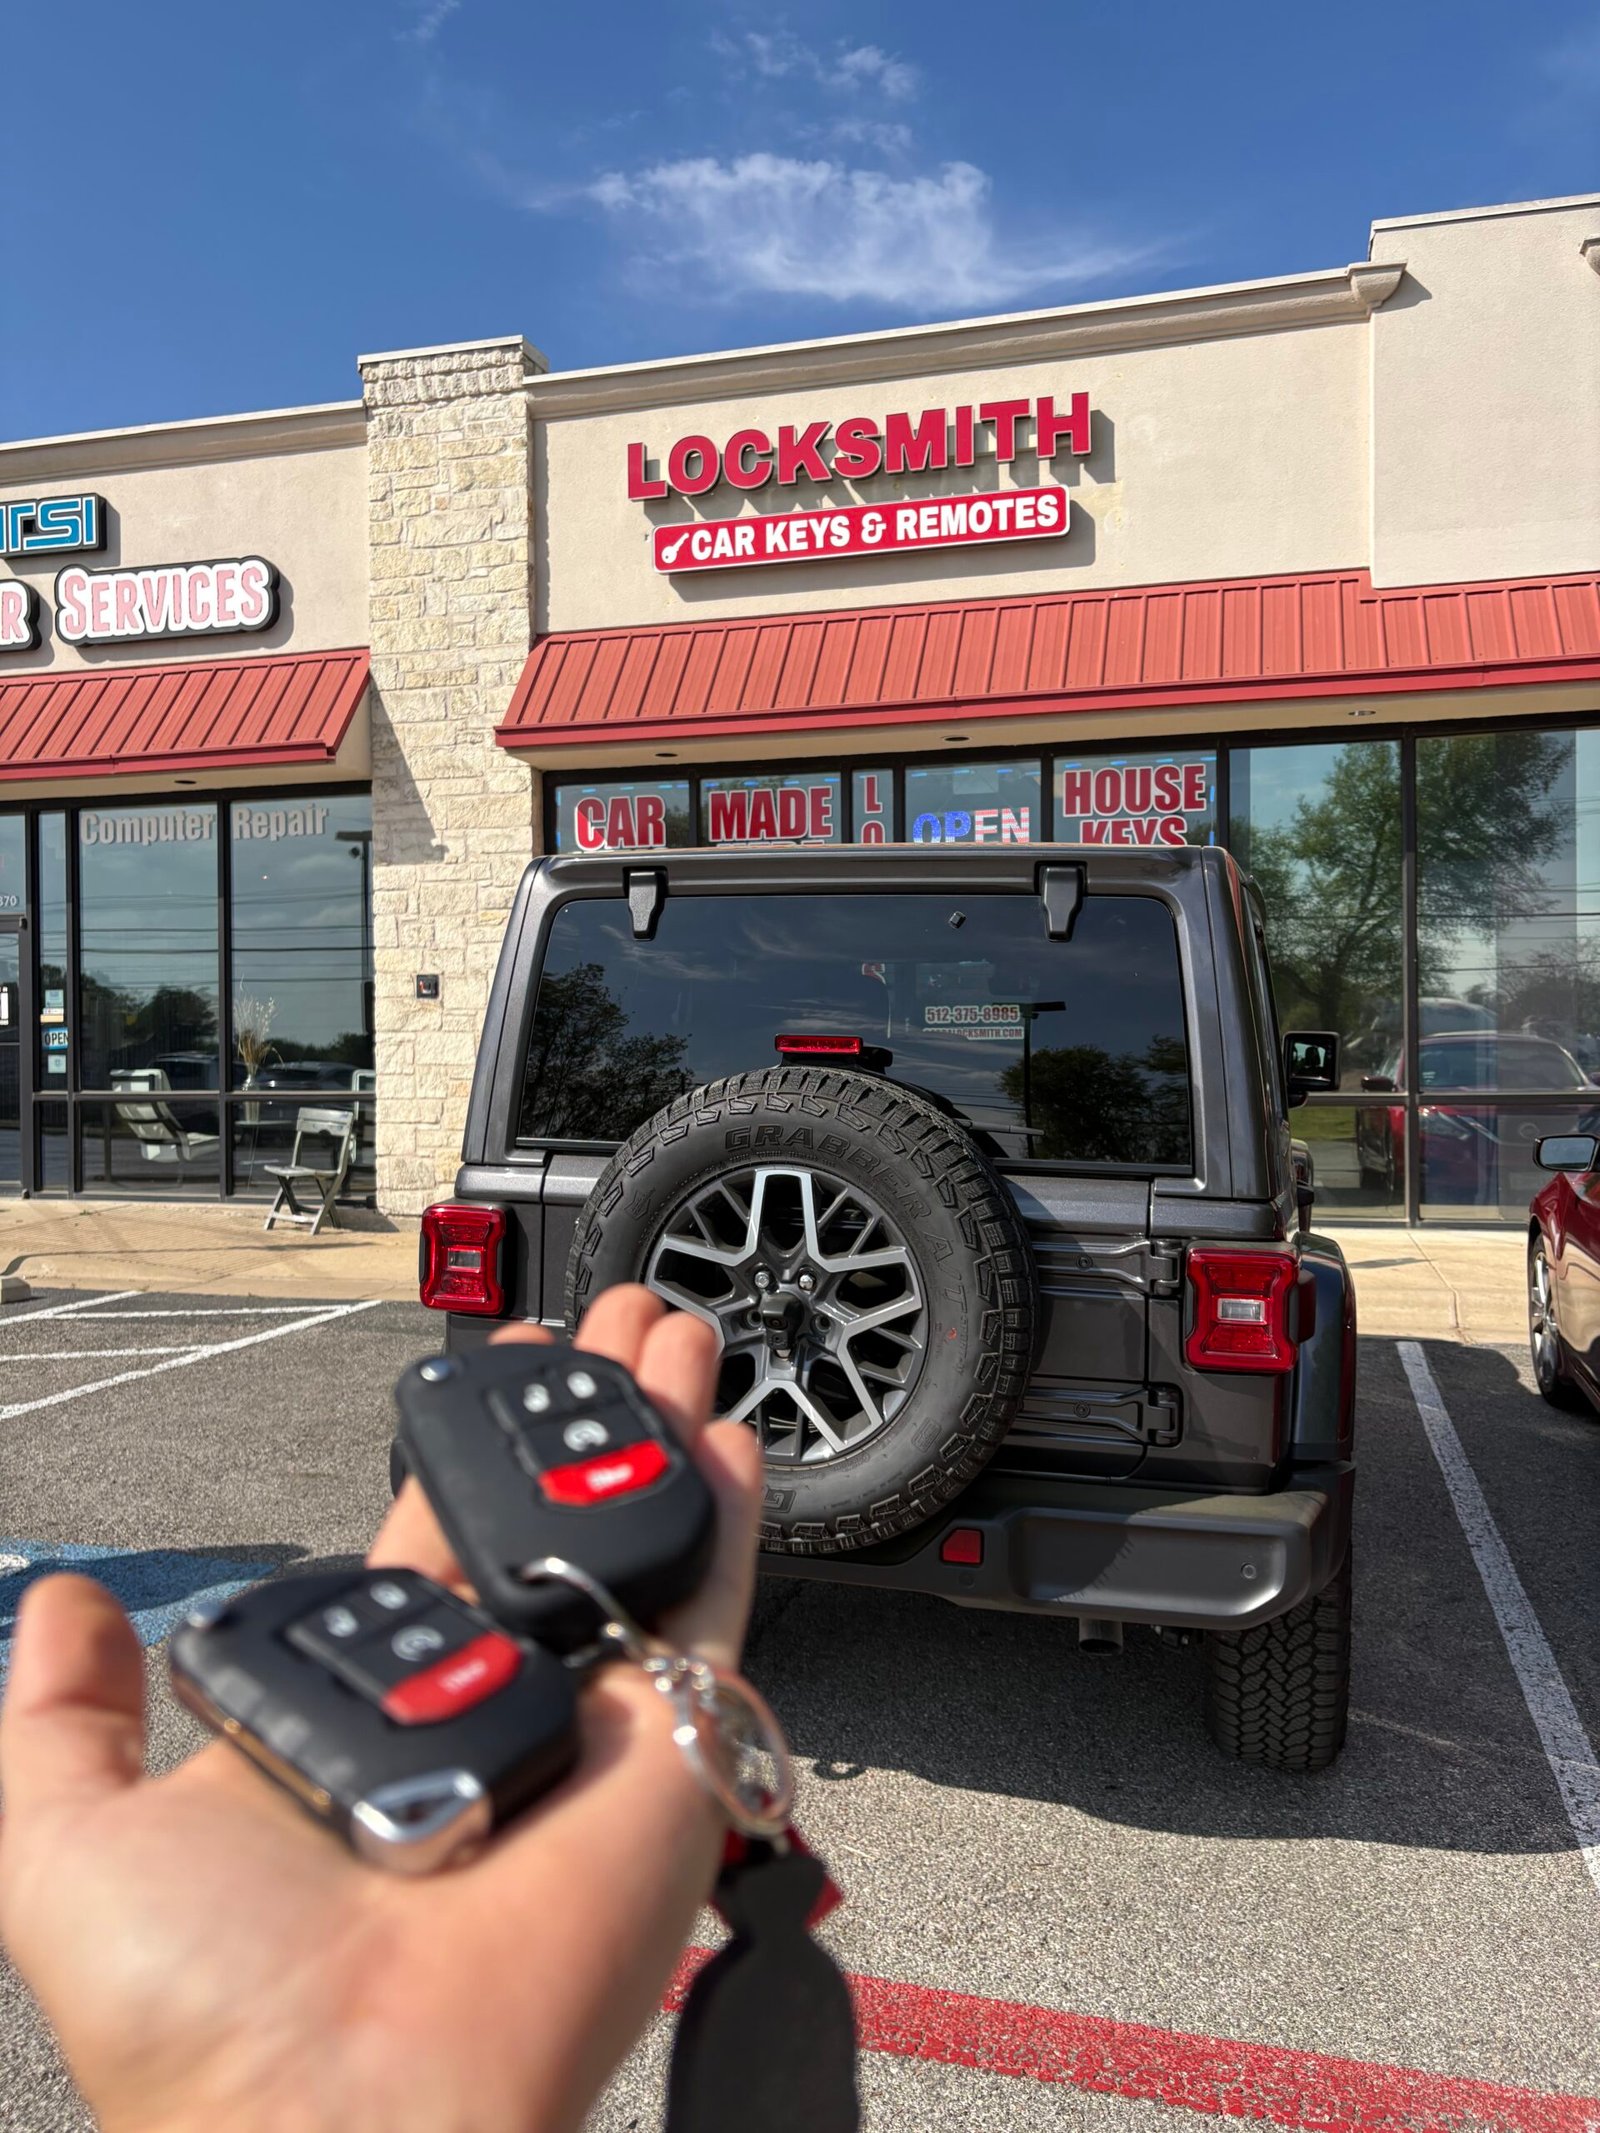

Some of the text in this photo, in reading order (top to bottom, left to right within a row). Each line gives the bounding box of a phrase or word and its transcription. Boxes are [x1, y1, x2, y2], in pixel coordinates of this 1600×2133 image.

[627, 391, 1092, 501] LOCKSMITH
[691, 494, 1059, 561] CAR KEYS & REMOTES
[63, 565, 265, 635] SERVICES
[709, 785, 834, 842] MADE
[1063, 764, 1207, 817] HOUSE
[79, 803, 329, 847] Computer Repair
[574, 796, 667, 851] CAR
[912, 806, 1031, 844] OPEN
[1080, 815, 1188, 845] KEYS
[925, 1005, 1020, 1024] 512-375-8985
[724, 1124, 931, 1219] GRABBER
